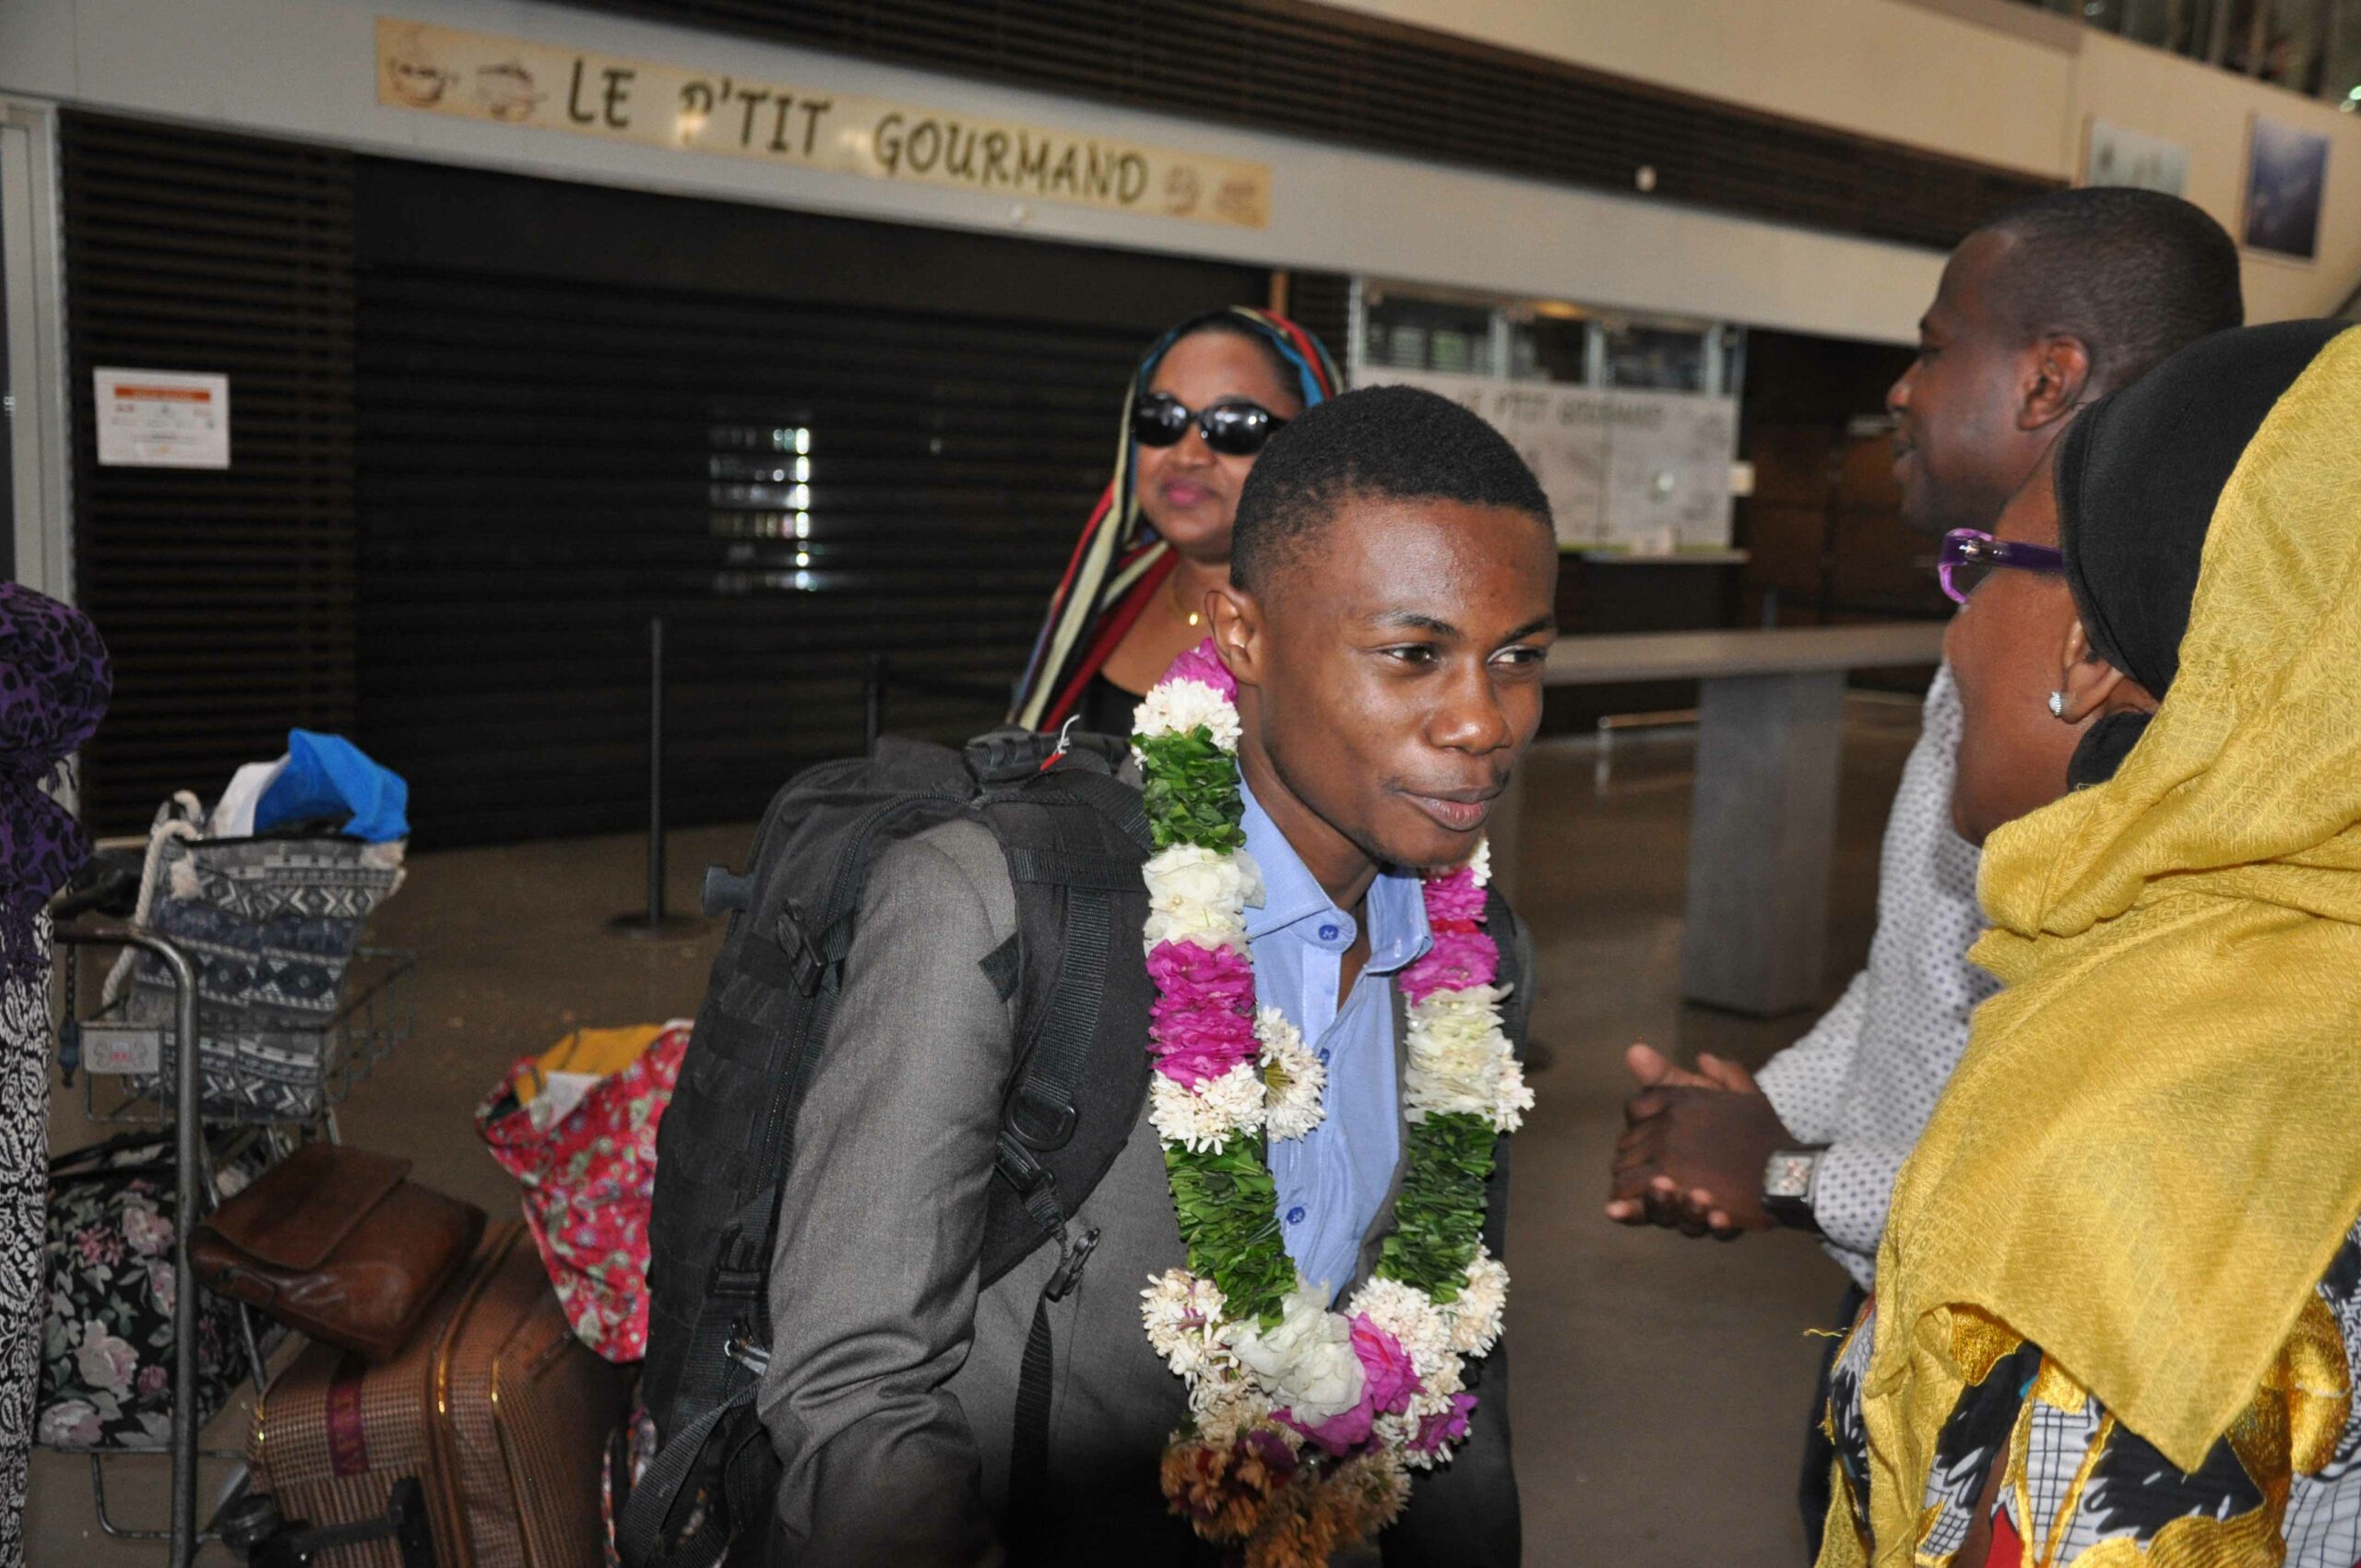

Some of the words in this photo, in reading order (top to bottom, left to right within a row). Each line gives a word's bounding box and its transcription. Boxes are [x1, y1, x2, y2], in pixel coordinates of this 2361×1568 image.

[567, 56, 635, 128] LE
[680, 76, 832, 156] P'TIT
[872, 112, 1148, 206] GOURMAND
